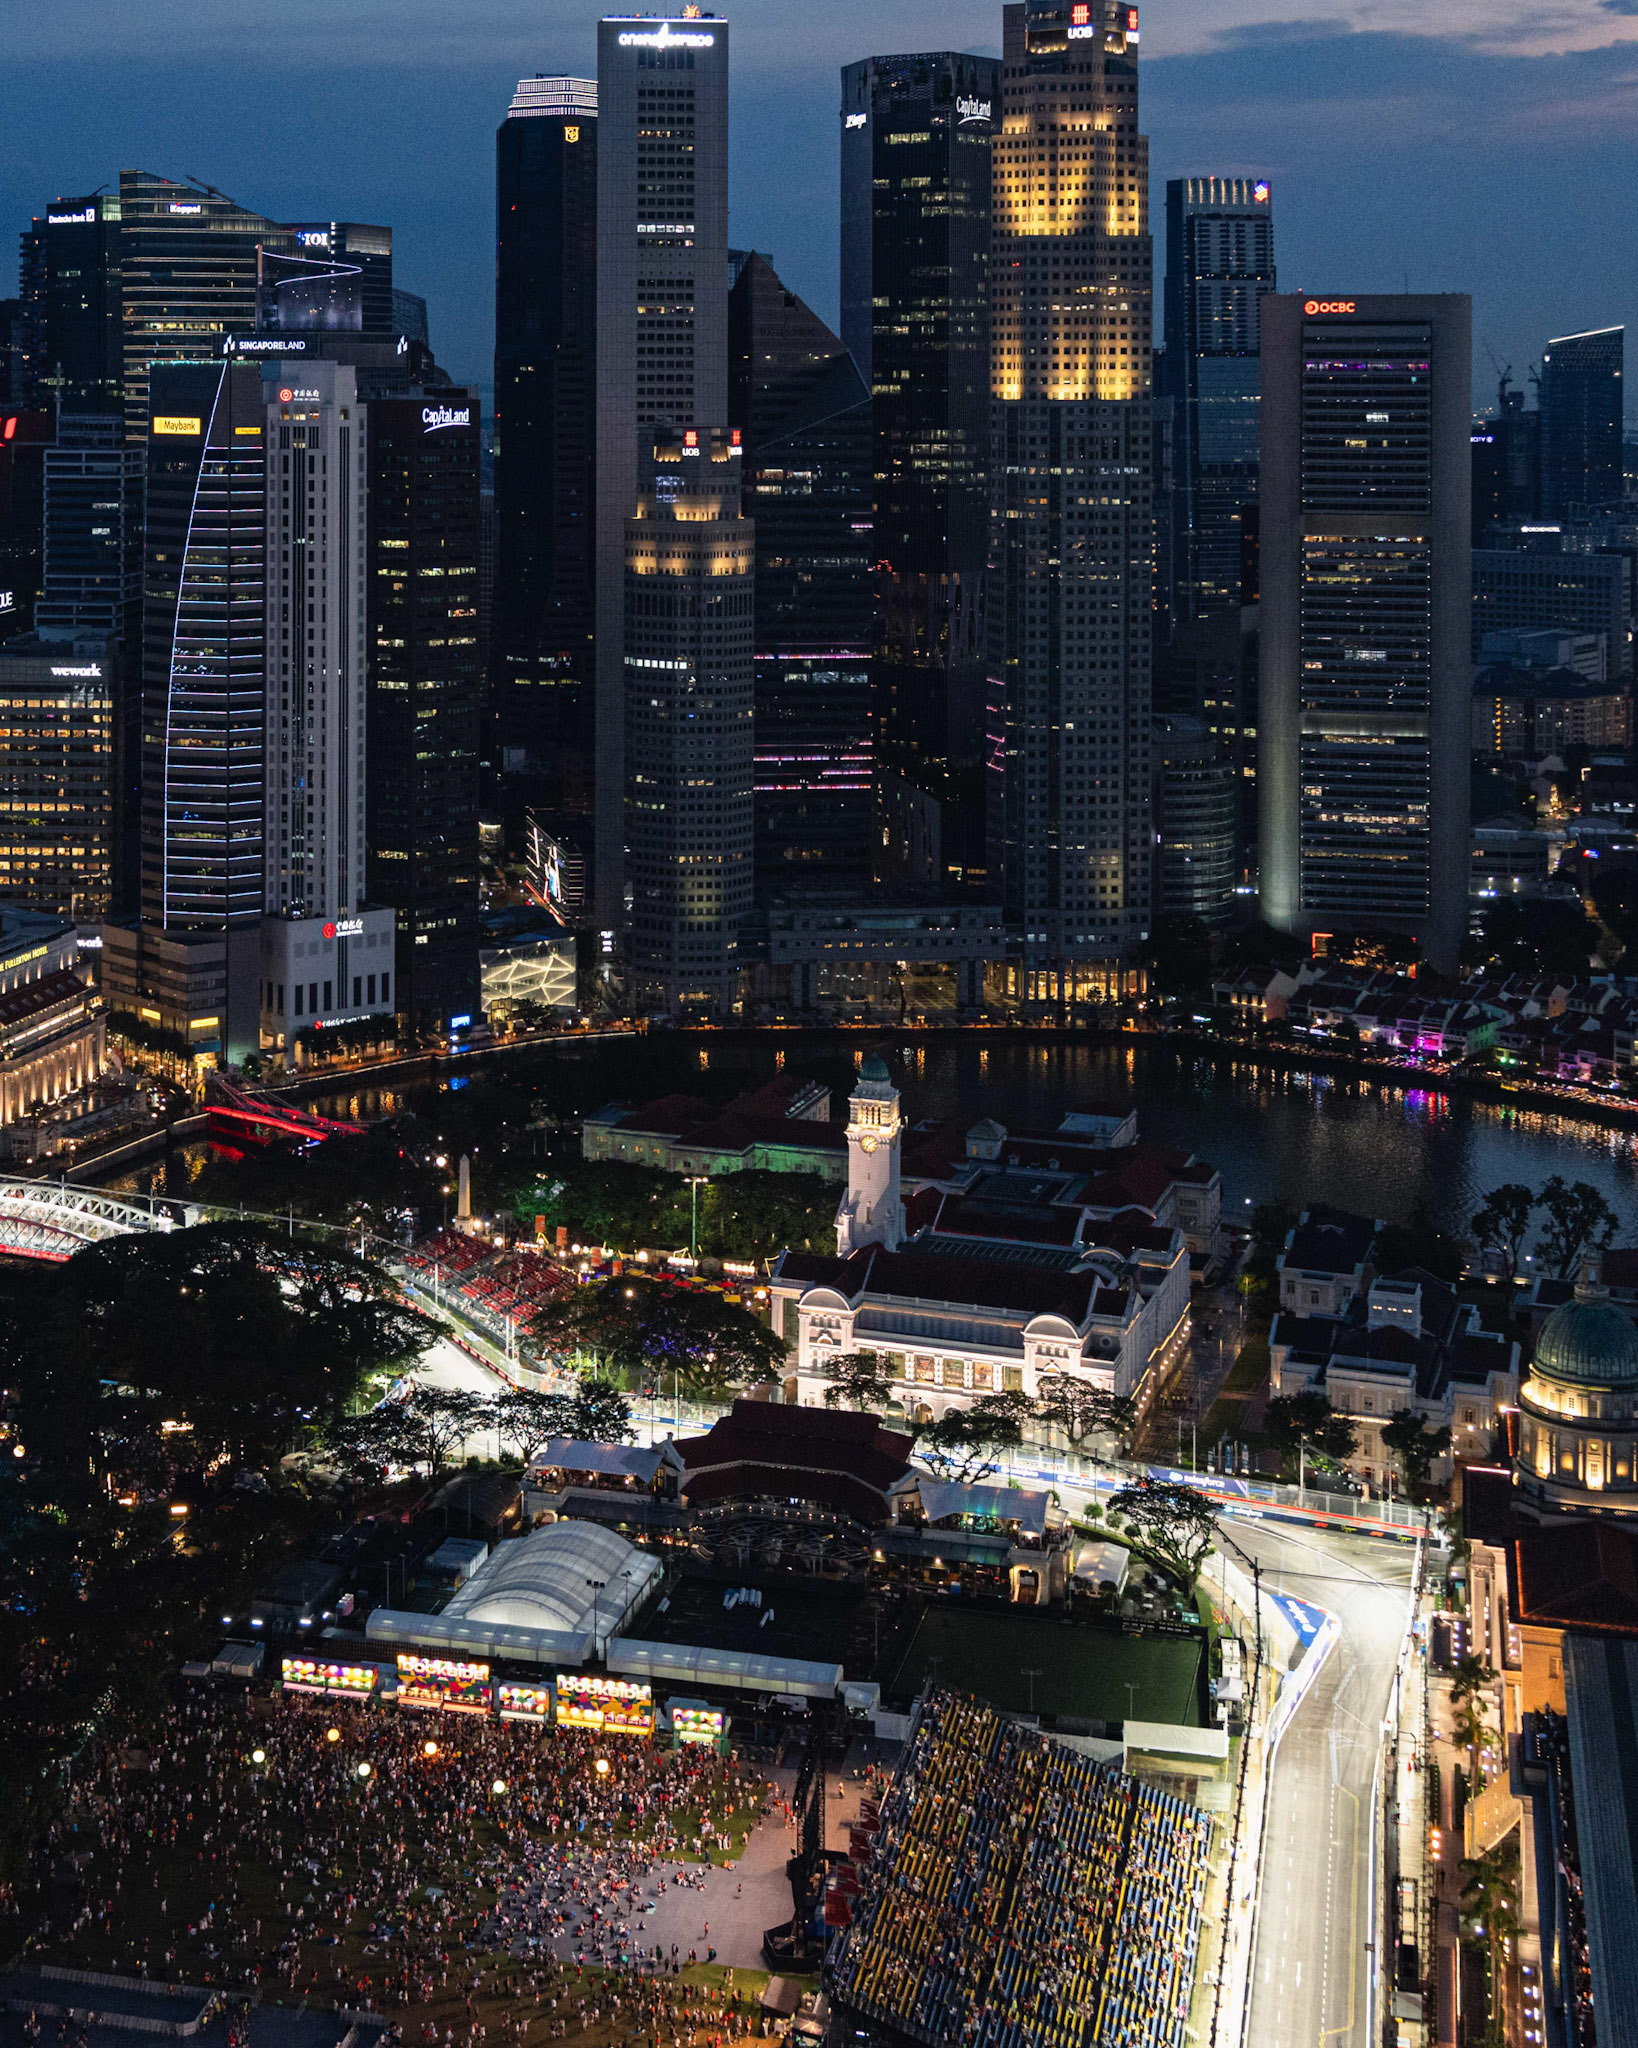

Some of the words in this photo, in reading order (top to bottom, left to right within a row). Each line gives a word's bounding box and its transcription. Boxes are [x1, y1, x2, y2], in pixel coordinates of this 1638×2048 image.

[1068, 27, 1093, 39] UOB
[956, 95, 991, 117] CapitaLand
[1320, 302, 1356, 313] OCBC
[422, 405, 470, 426] CapitaLand
[163, 419, 196, 432] Maybank
[682, 447, 700, 456] UOB
[51, 663, 102, 677] wework
[32, 945, 48, 959] HOTEL
[1183, 1475, 1225, 1488] salesforce
[402, 1661, 484, 1681] DOCKSIDE
[563, 1681, 648, 1700] DOCKSIDE
